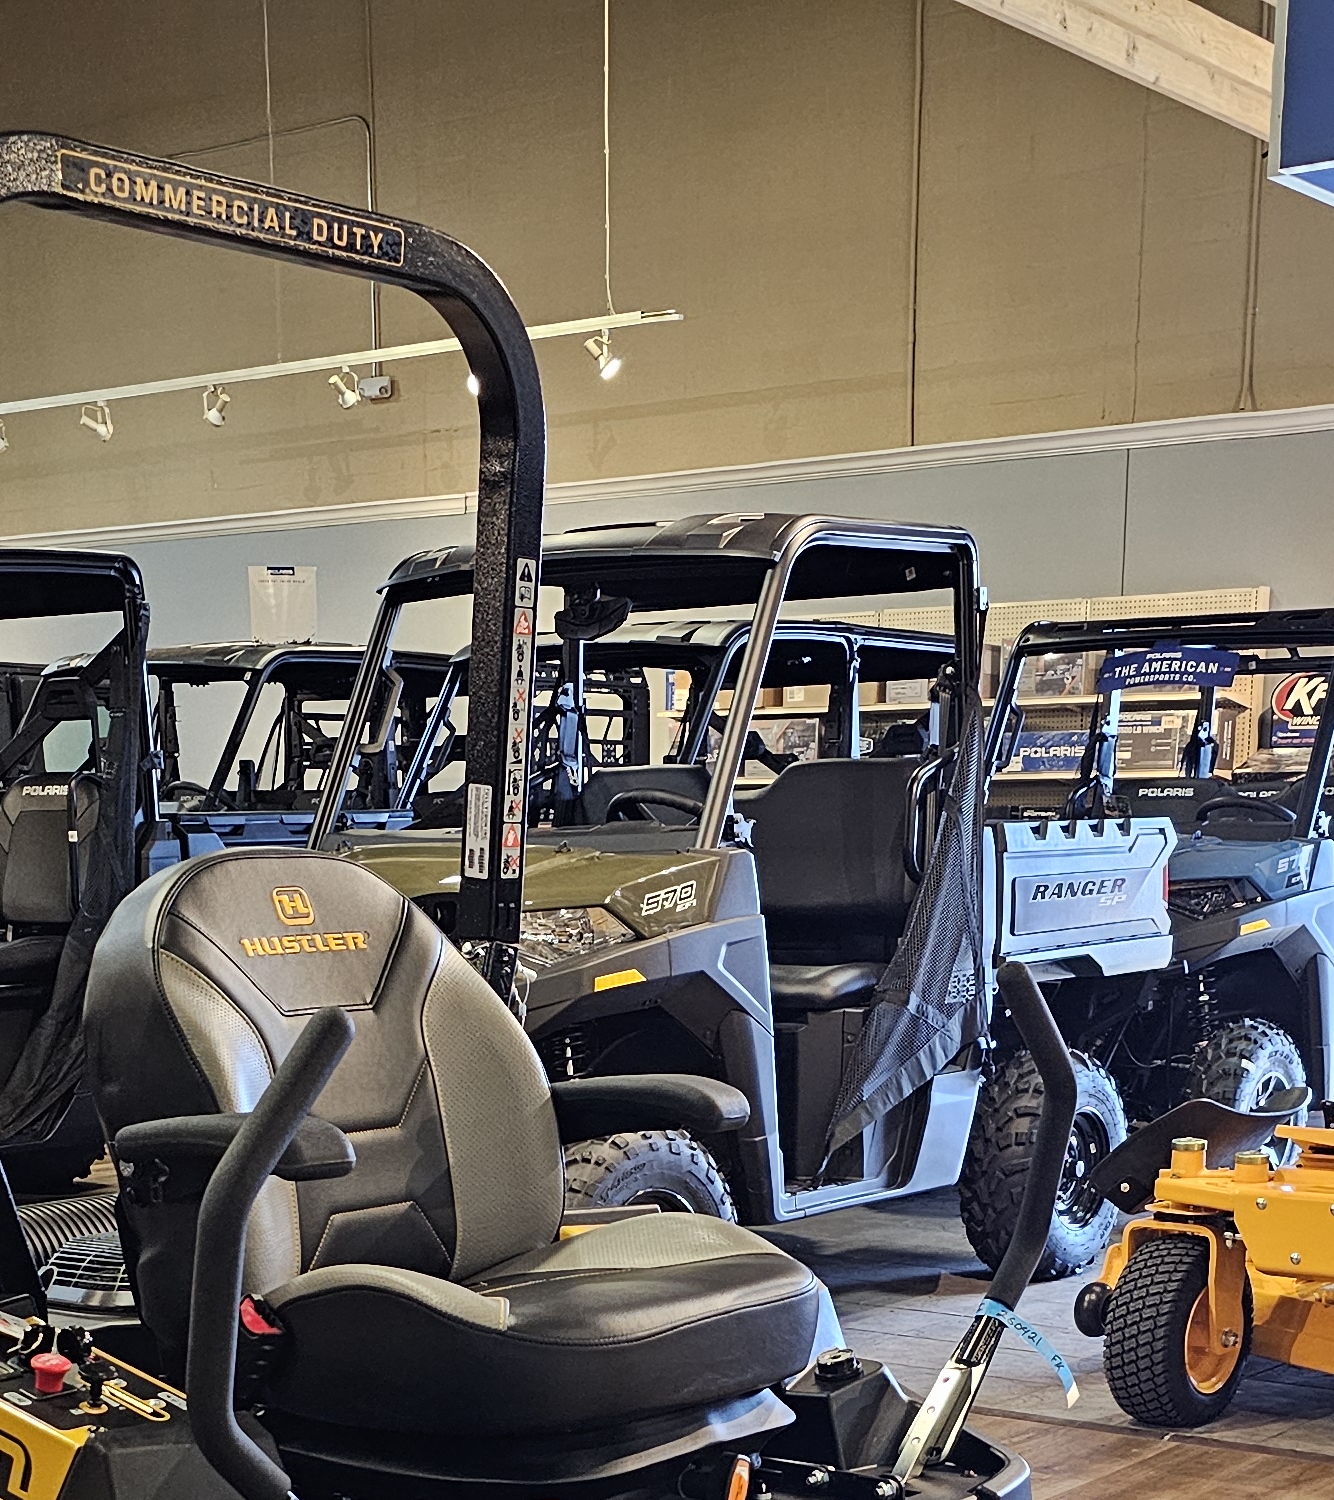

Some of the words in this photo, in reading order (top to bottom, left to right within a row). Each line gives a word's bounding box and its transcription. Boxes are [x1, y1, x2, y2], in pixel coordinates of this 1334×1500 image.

[89, 166, 298, 236] COMMERCIAL
[312, 217, 384, 254] DUTY
[1146, 652, 1182, 660] POLARIS
[1114, 663, 1138, 679] THE
[1141, 660, 1219, 674] AMERICAN
[1125, 674, 1180, 685] POWERSPORTS
[1182, 674, 1197, 682] CO.
[1019, 745, 1086, 758] POLARIS
[1138, 787, 1194, 797] POLARIS
[1030, 877, 1127, 902] RANGER
[641, 880, 697, 916] 570
[1098, 893, 1127, 907] SP
[241, 930, 368, 958] HUSTLER
